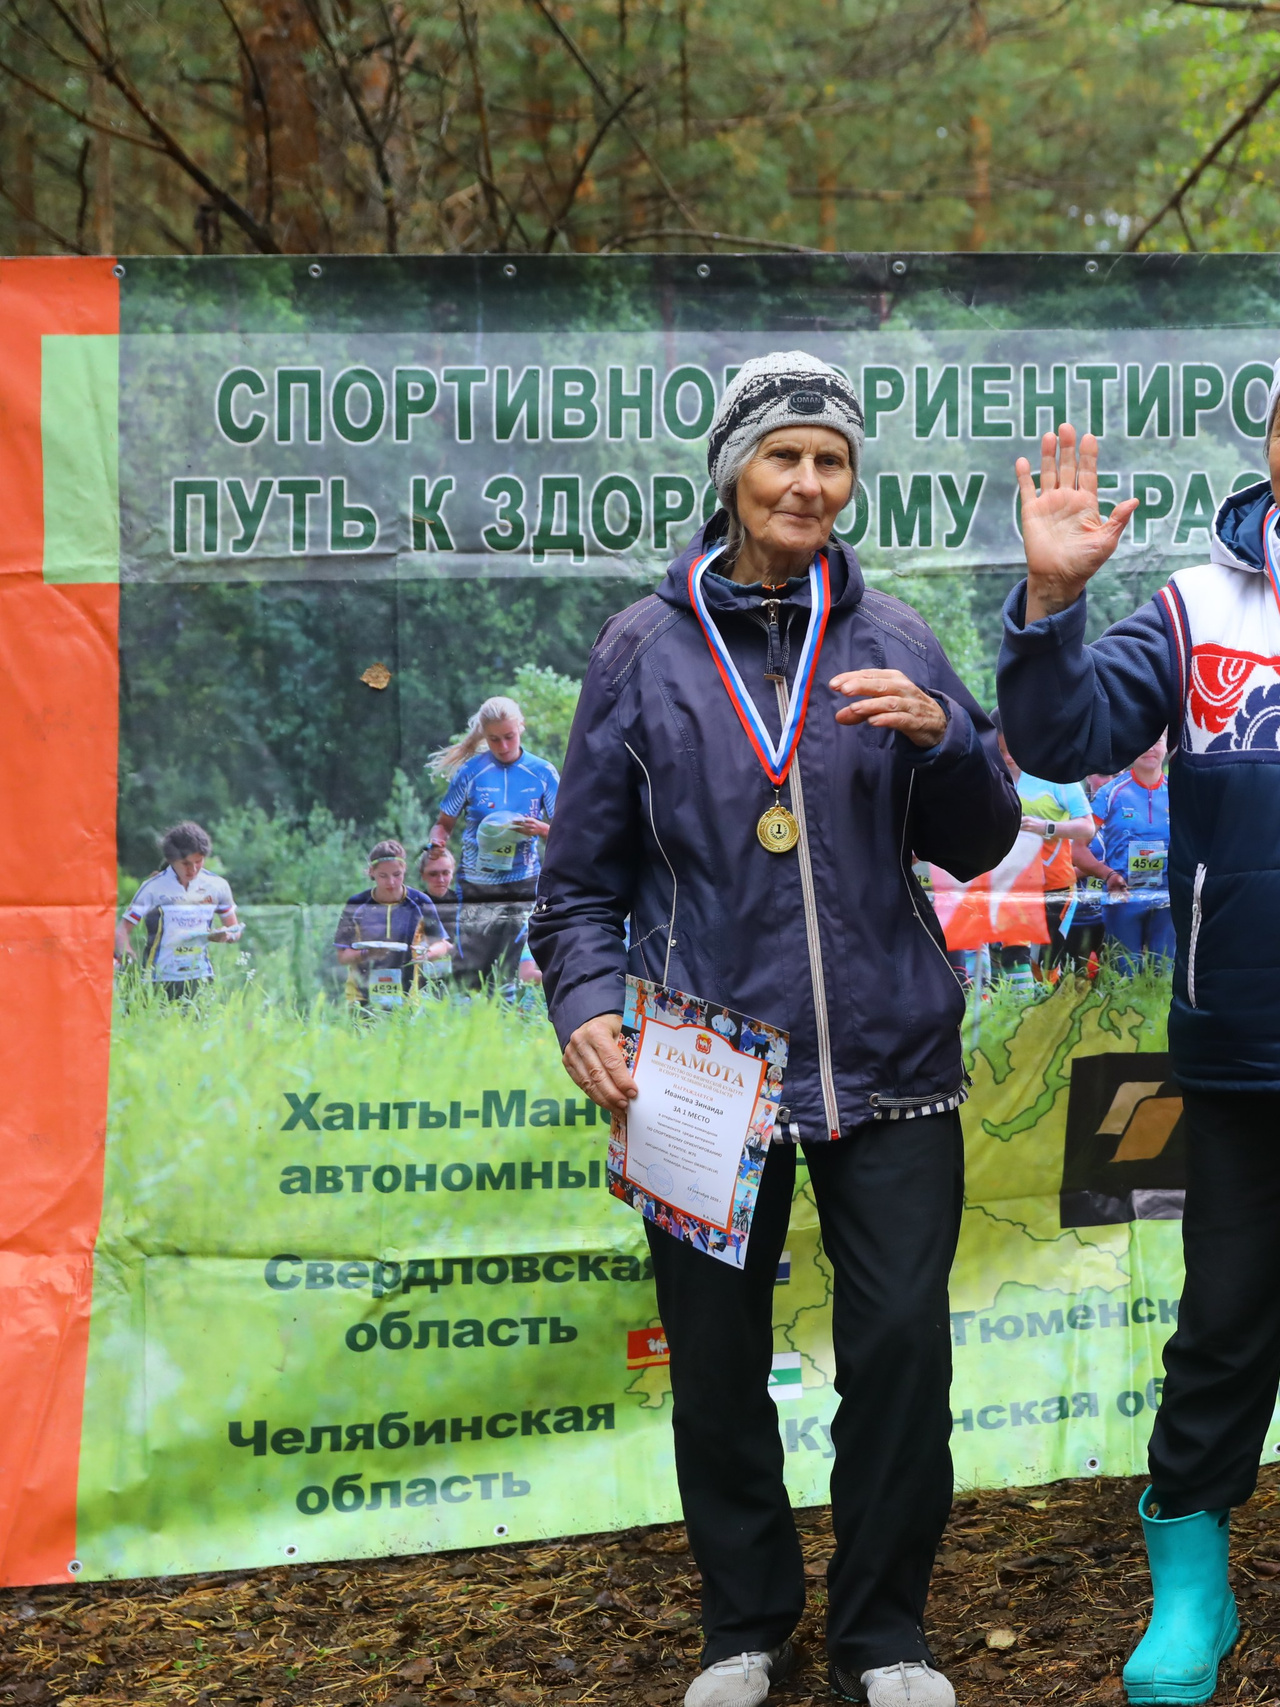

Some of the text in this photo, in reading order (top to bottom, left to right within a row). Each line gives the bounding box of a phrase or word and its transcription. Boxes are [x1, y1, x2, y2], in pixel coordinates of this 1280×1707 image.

[792, 396, 821, 404] LOMAN
[172, 475, 380, 554] ПУТЬ
[410, 474, 455, 553] К
[775, 823, 782, 834] 1
[653, 1040, 745, 1089] ГРАМОТА
[664, 1088, 723, 1116] Иванова Зинаида
[672, 1083, 713, 1102] НАГРАЖДАЕТСЯ
[673, 1105, 681, 1114] ЗА
[687, 1111, 710, 1124] МЕСТО
[279, 1159, 609, 1195] автономны
[345, 1310, 578, 1352] область
[228, 1403, 615, 1456] Челябинская
[296, 1471, 531, 1515] область
